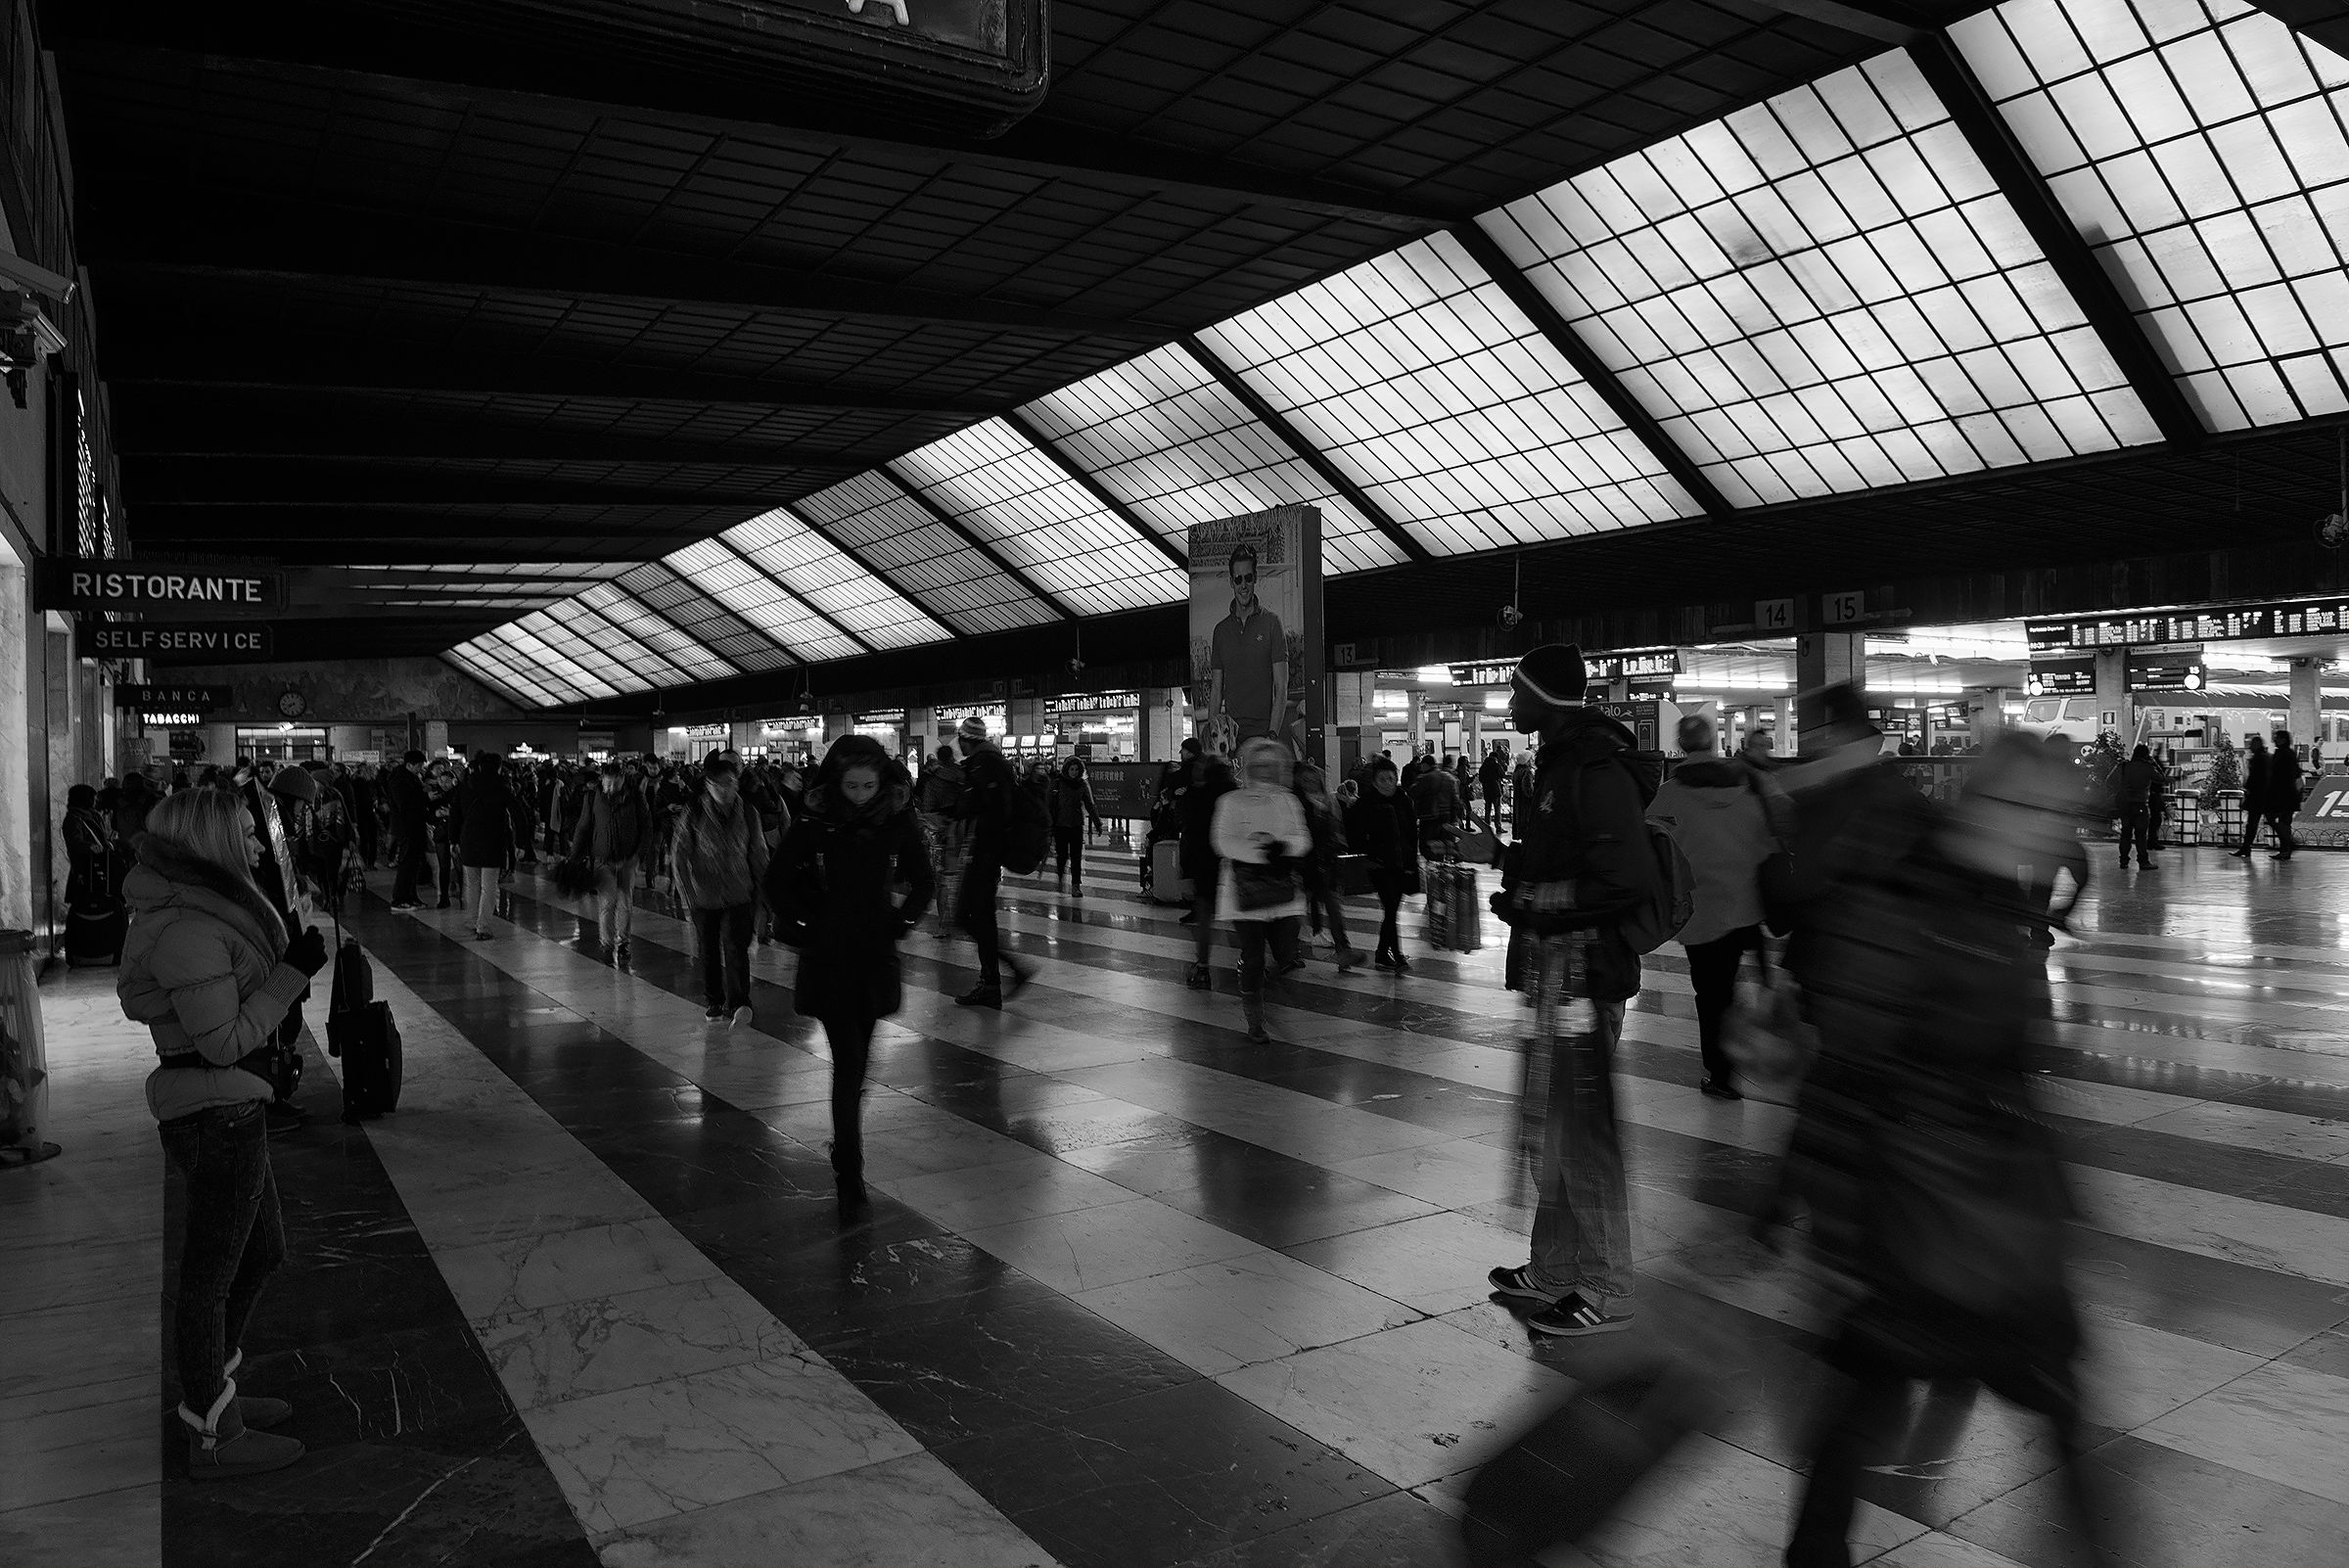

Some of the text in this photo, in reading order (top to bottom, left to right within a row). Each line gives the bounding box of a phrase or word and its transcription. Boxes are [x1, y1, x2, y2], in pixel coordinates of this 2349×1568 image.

[71, 572, 263, 603] RISTORANTE
[1765, 602, 1786, 626] 14
[1834, 596, 1856, 622] 15
[1341, 647, 1353, 665] 13
[142, 690, 210, 702] BANCA
[142, 713, 200, 724] TABACCHI
